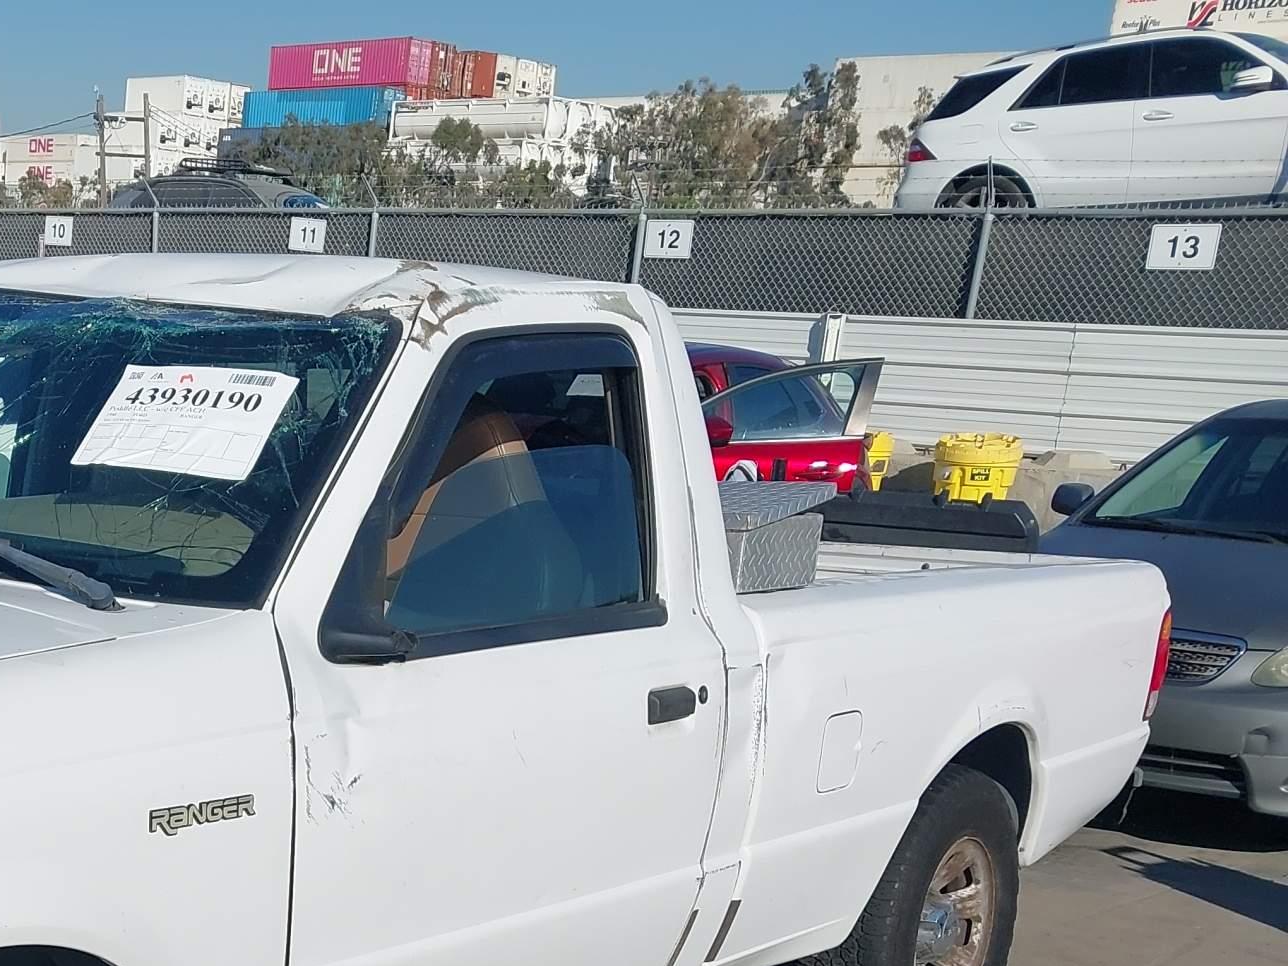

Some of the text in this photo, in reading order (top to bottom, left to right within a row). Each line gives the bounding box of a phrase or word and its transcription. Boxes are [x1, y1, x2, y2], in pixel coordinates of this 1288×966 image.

[312, 47, 361, 73] ONE
[29, 138, 53, 152] ONE
[52, 223, 66, 238] 10
[301, 226, 316, 244] 11
[658, 229, 681, 249] 12
[1168, 235, 1200, 259] 13
[125, 386, 263, 413] 43930190
[149, 794, 255, 836] RANGER
